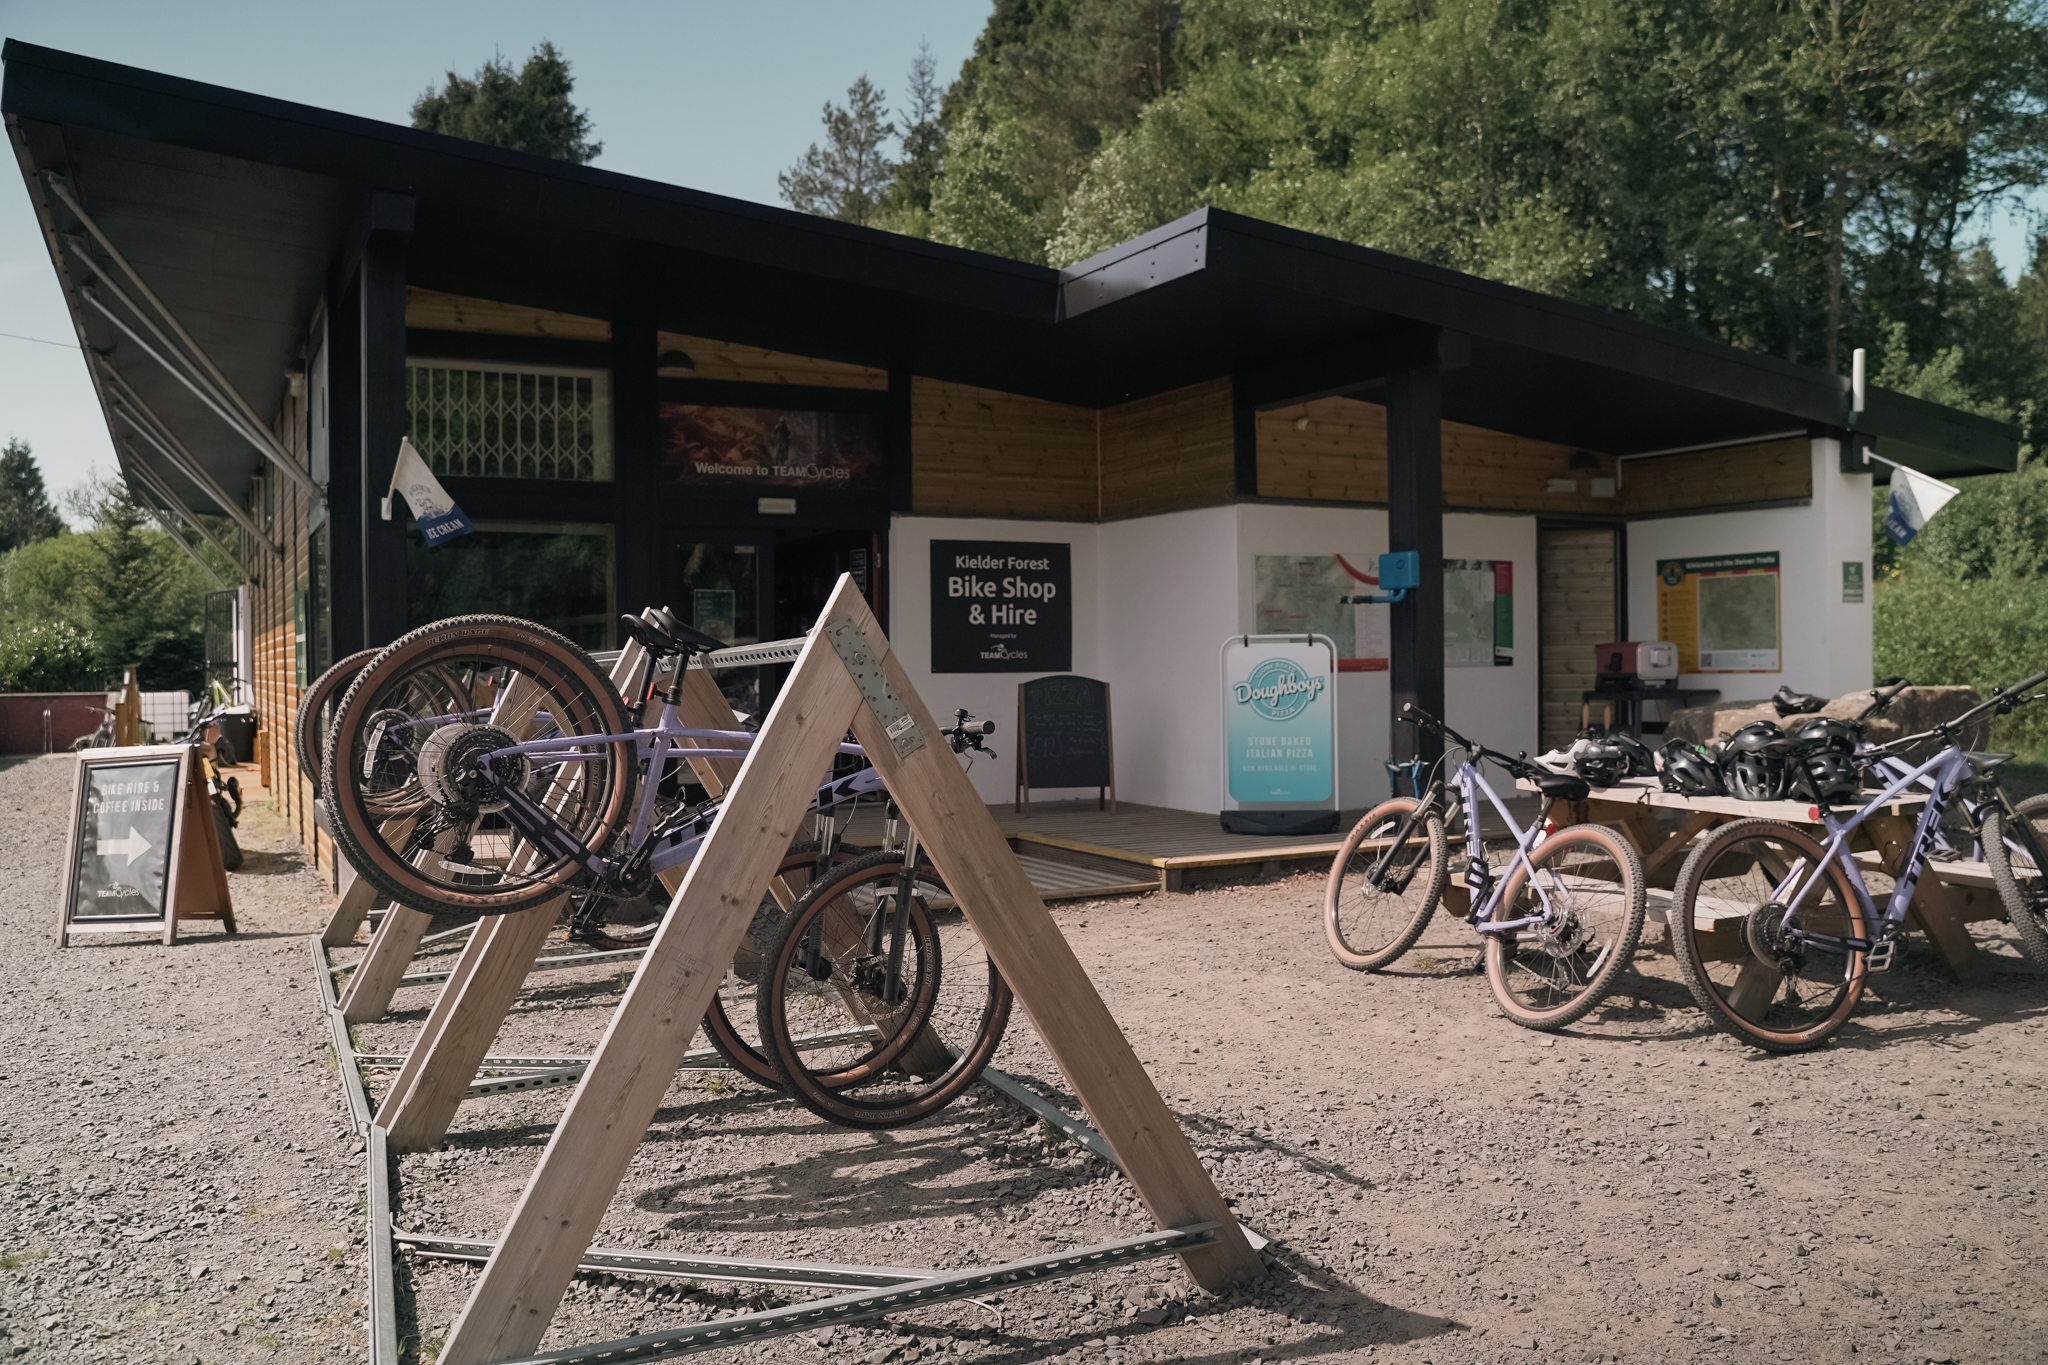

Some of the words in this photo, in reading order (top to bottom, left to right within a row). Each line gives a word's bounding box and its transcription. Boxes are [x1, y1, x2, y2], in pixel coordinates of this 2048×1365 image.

[695, 461, 753, 476] Welcome
[756, 465, 769, 476] to
[772, 463, 850, 480] TEAMCycles
[425, 527, 440, 540] ICE
[436, 518, 465, 536] CREAM
[955, 555, 1005, 569] Kielder
[1007, 556, 1050, 570] Forest
[1685, 561, 1715, 569] Welcome
[948, 575, 997, 598] Bike
[1002, 575, 1056, 603] Shop
[968, 603, 986, 625] &
[991, 603, 1037, 625] Hire
[980, 649, 1028, 661] TEAMCycles
[1233, 672, 1323, 708] Doughboys
[1271, 707, 1295, 717] PIZZA
[1248, 736, 1277, 746] STONE
[1281, 736, 1312, 746] BAKED
[1246, 748, 1283, 758] ITALIAN
[1286, 748, 1313, 758] PIZZA
[101, 783, 123, 796] BIKE
[127, 781, 150, 794] HIRE
[153, 780, 159, 793] &
[93, 800, 128, 814] COFFEE
[131, 798, 165, 812] INSIDE
[1349, 812, 1376, 842] MAXXIS
[1730, 826, 1774, 838] MAXXIS
[1903, 781, 1951, 889] TREK
[97, 888, 140, 899] TEAMCycles
[446, 893, 520, 905] MAXXIS
